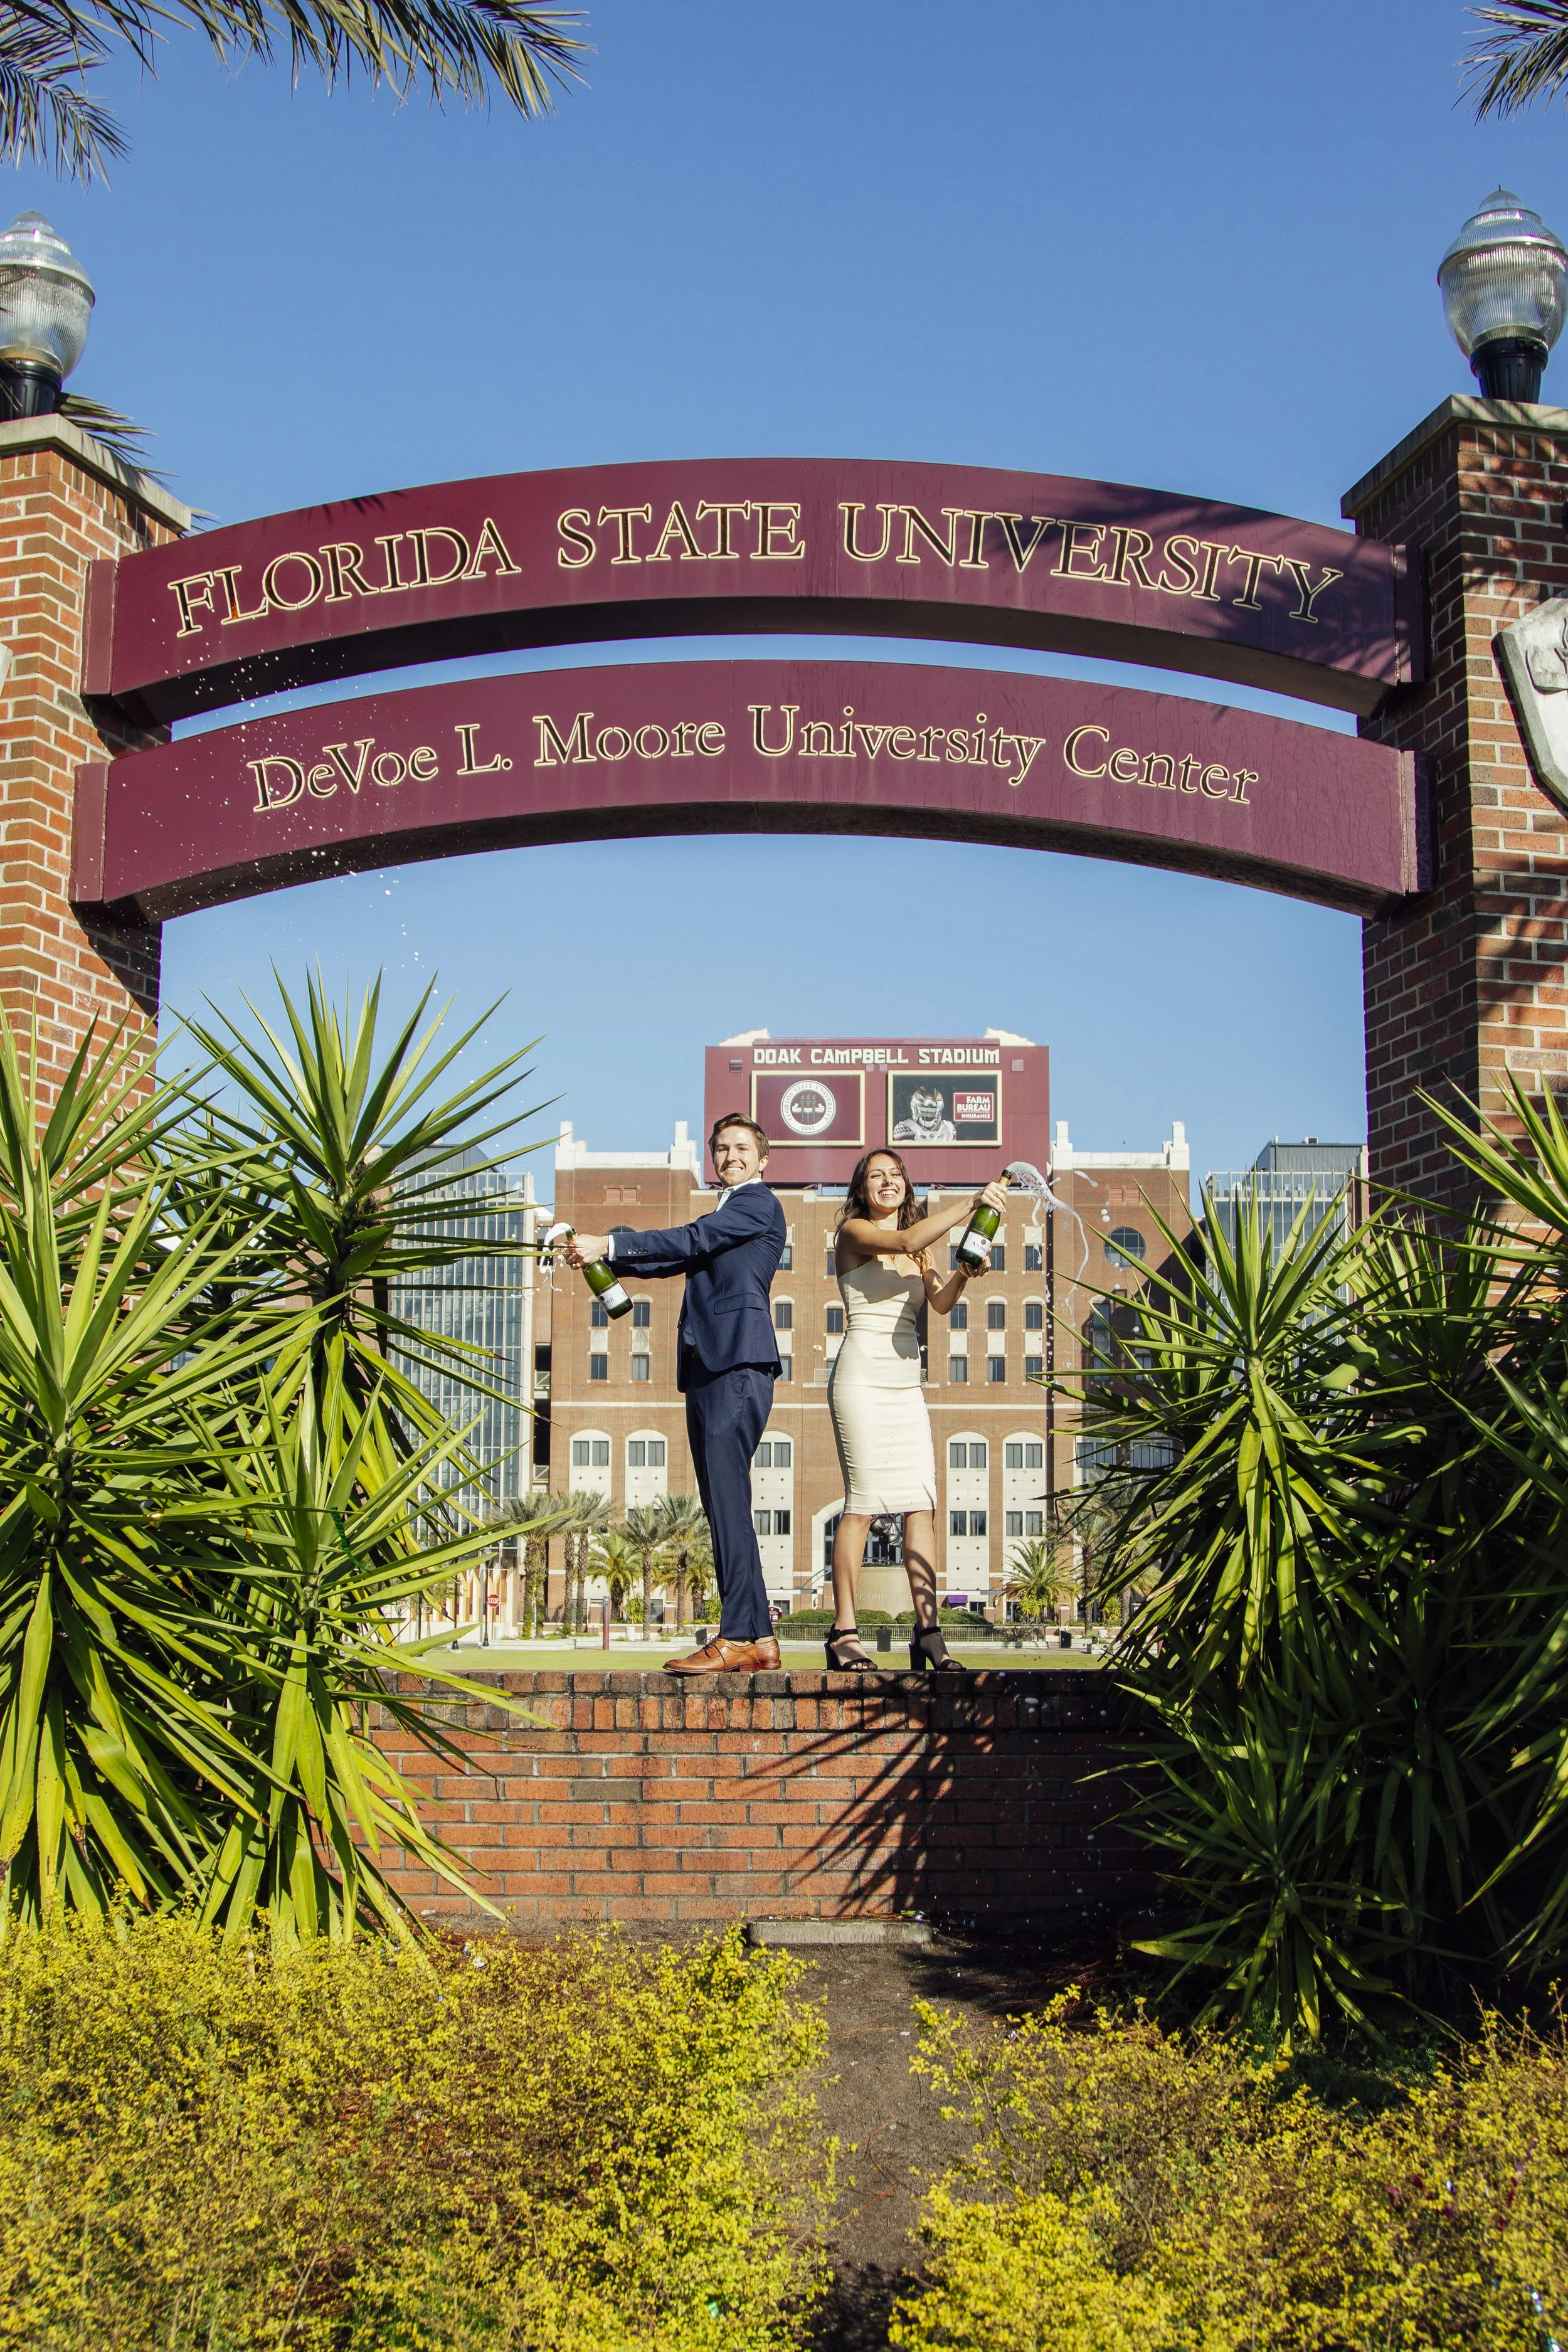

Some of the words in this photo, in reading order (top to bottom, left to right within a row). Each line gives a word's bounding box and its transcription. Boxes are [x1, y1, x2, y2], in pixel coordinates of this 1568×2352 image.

[167, 518, 522, 638] FLORIDA
[557, 500, 805, 569] STATE
[838, 502, 1344, 624] UNIVERSITY
[246, 738, 438, 812] DeVoe
[455, 723, 513, 775] L.
[532, 712, 726, 768] Moore
[747, 704, 1046, 787] University
[1062, 724, 1259, 805] Center
[753, 1048, 802, 1064] DOAK
[810, 1048, 909, 1064] CAMPBELL
[918, 1048, 1000, 1064] STADIUM
[784, 1093, 793, 1121] FLORIDA
[793, 1083, 813, 1092] STATE
[815, 1085, 832, 1121] UNIVERSITY
[956, 1103, 990, 1111] BUREAU
[967, 1096, 990, 1104] FARM
[856, 1592, 913, 1601] NCONQUERE
